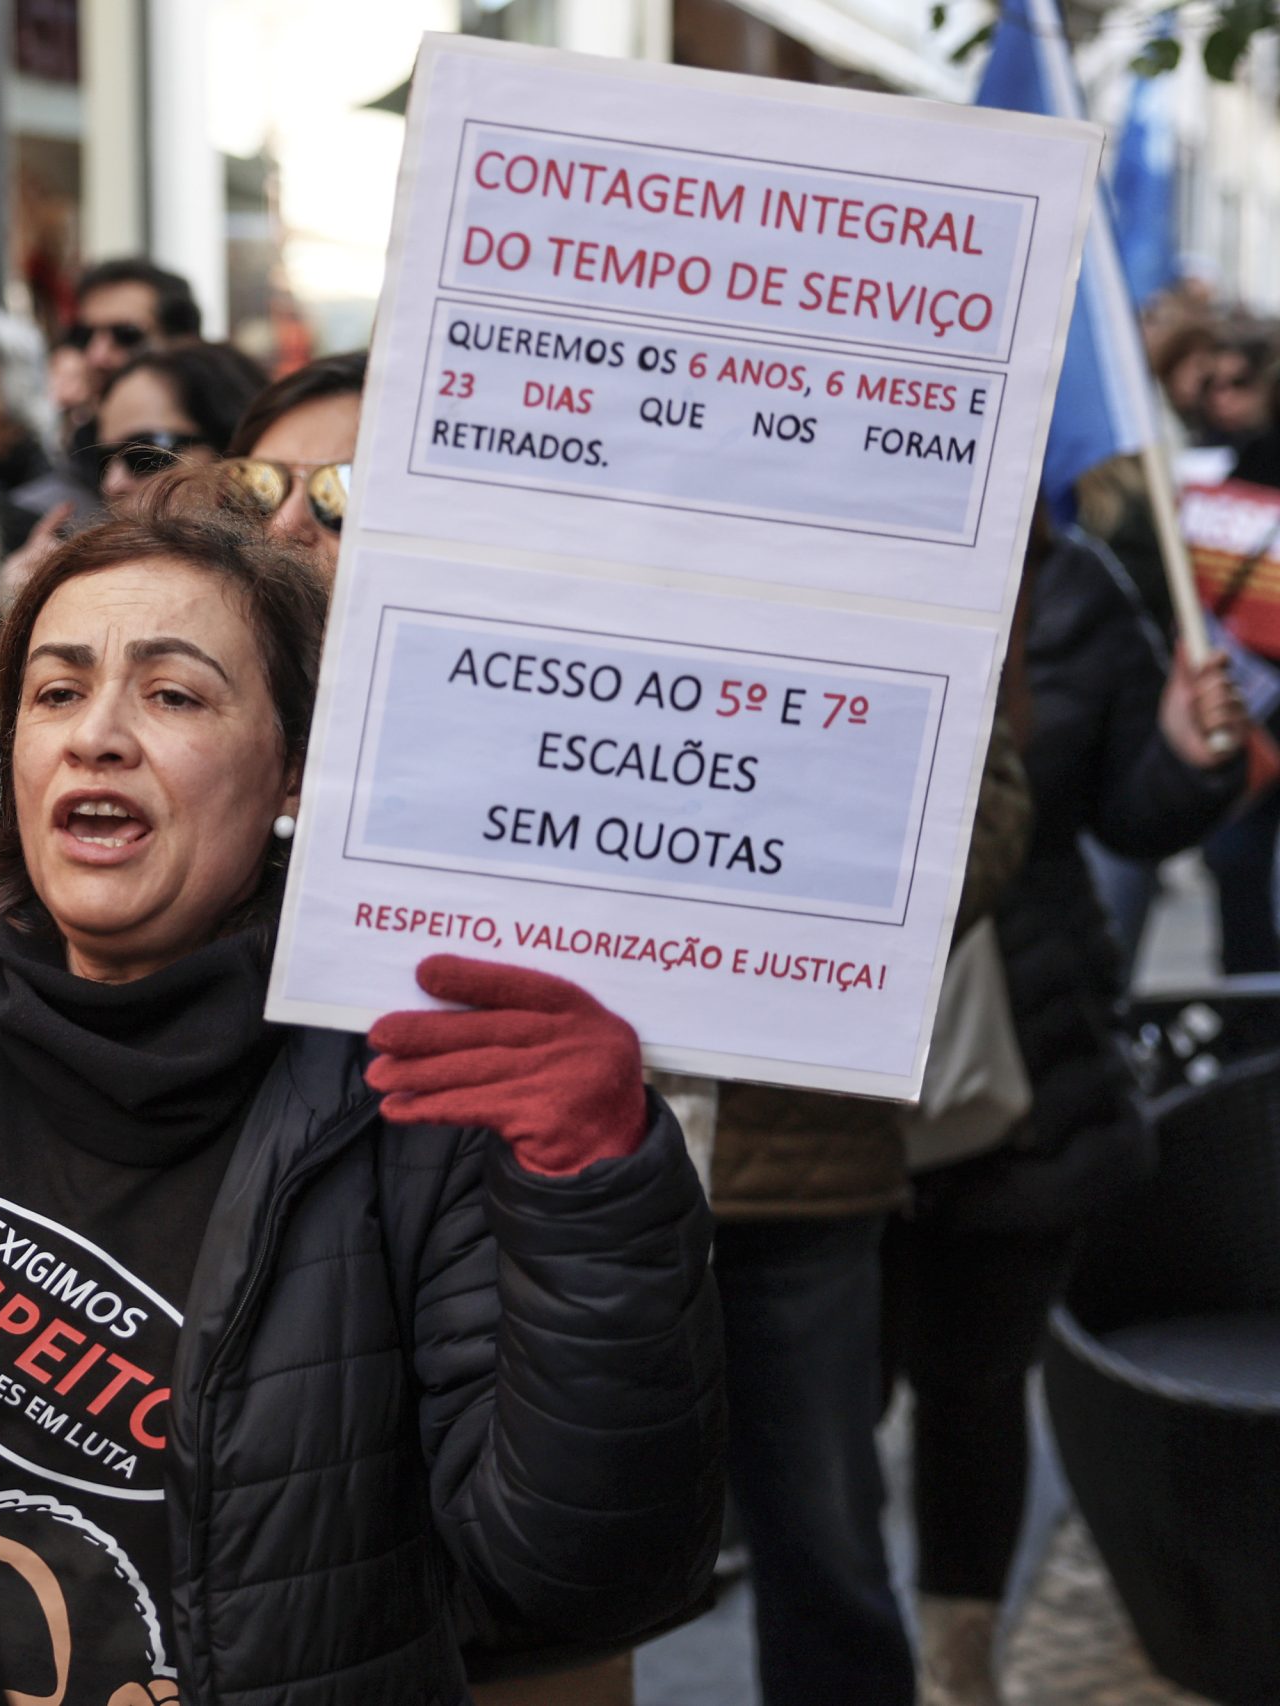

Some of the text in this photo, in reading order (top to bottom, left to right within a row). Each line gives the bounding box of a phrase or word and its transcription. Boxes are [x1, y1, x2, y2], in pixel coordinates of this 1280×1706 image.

[475, 151, 982, 255] CONTAGEM INTEGRAL
[463, 227, 992, 337] DO TEMPO DE SERVIÇO
[449, 321, 986, 415] QUEREMOS OS 6 ANOS, 6 MESES E
[433, 420, 607, 467] RETIRADOS.
[439, 370, 975, 464] 23 DIAS QUE NOS FORAM
[449, 649, 622, 702] ACESSO
[635, 672, 701, 711] AO
[781, 689, 806, 725] E
[539, 732, 758, 792] ESCALÕES
[484, 806, 783, 874] SEM QUOTAS
[355, 903, 886, 992] RESPEITO, VALORIZAÇÃO E JUSTIÇA!
[25, 1396, 68, 1433] EM
[65, 1422, 137, 1479] LUTA
